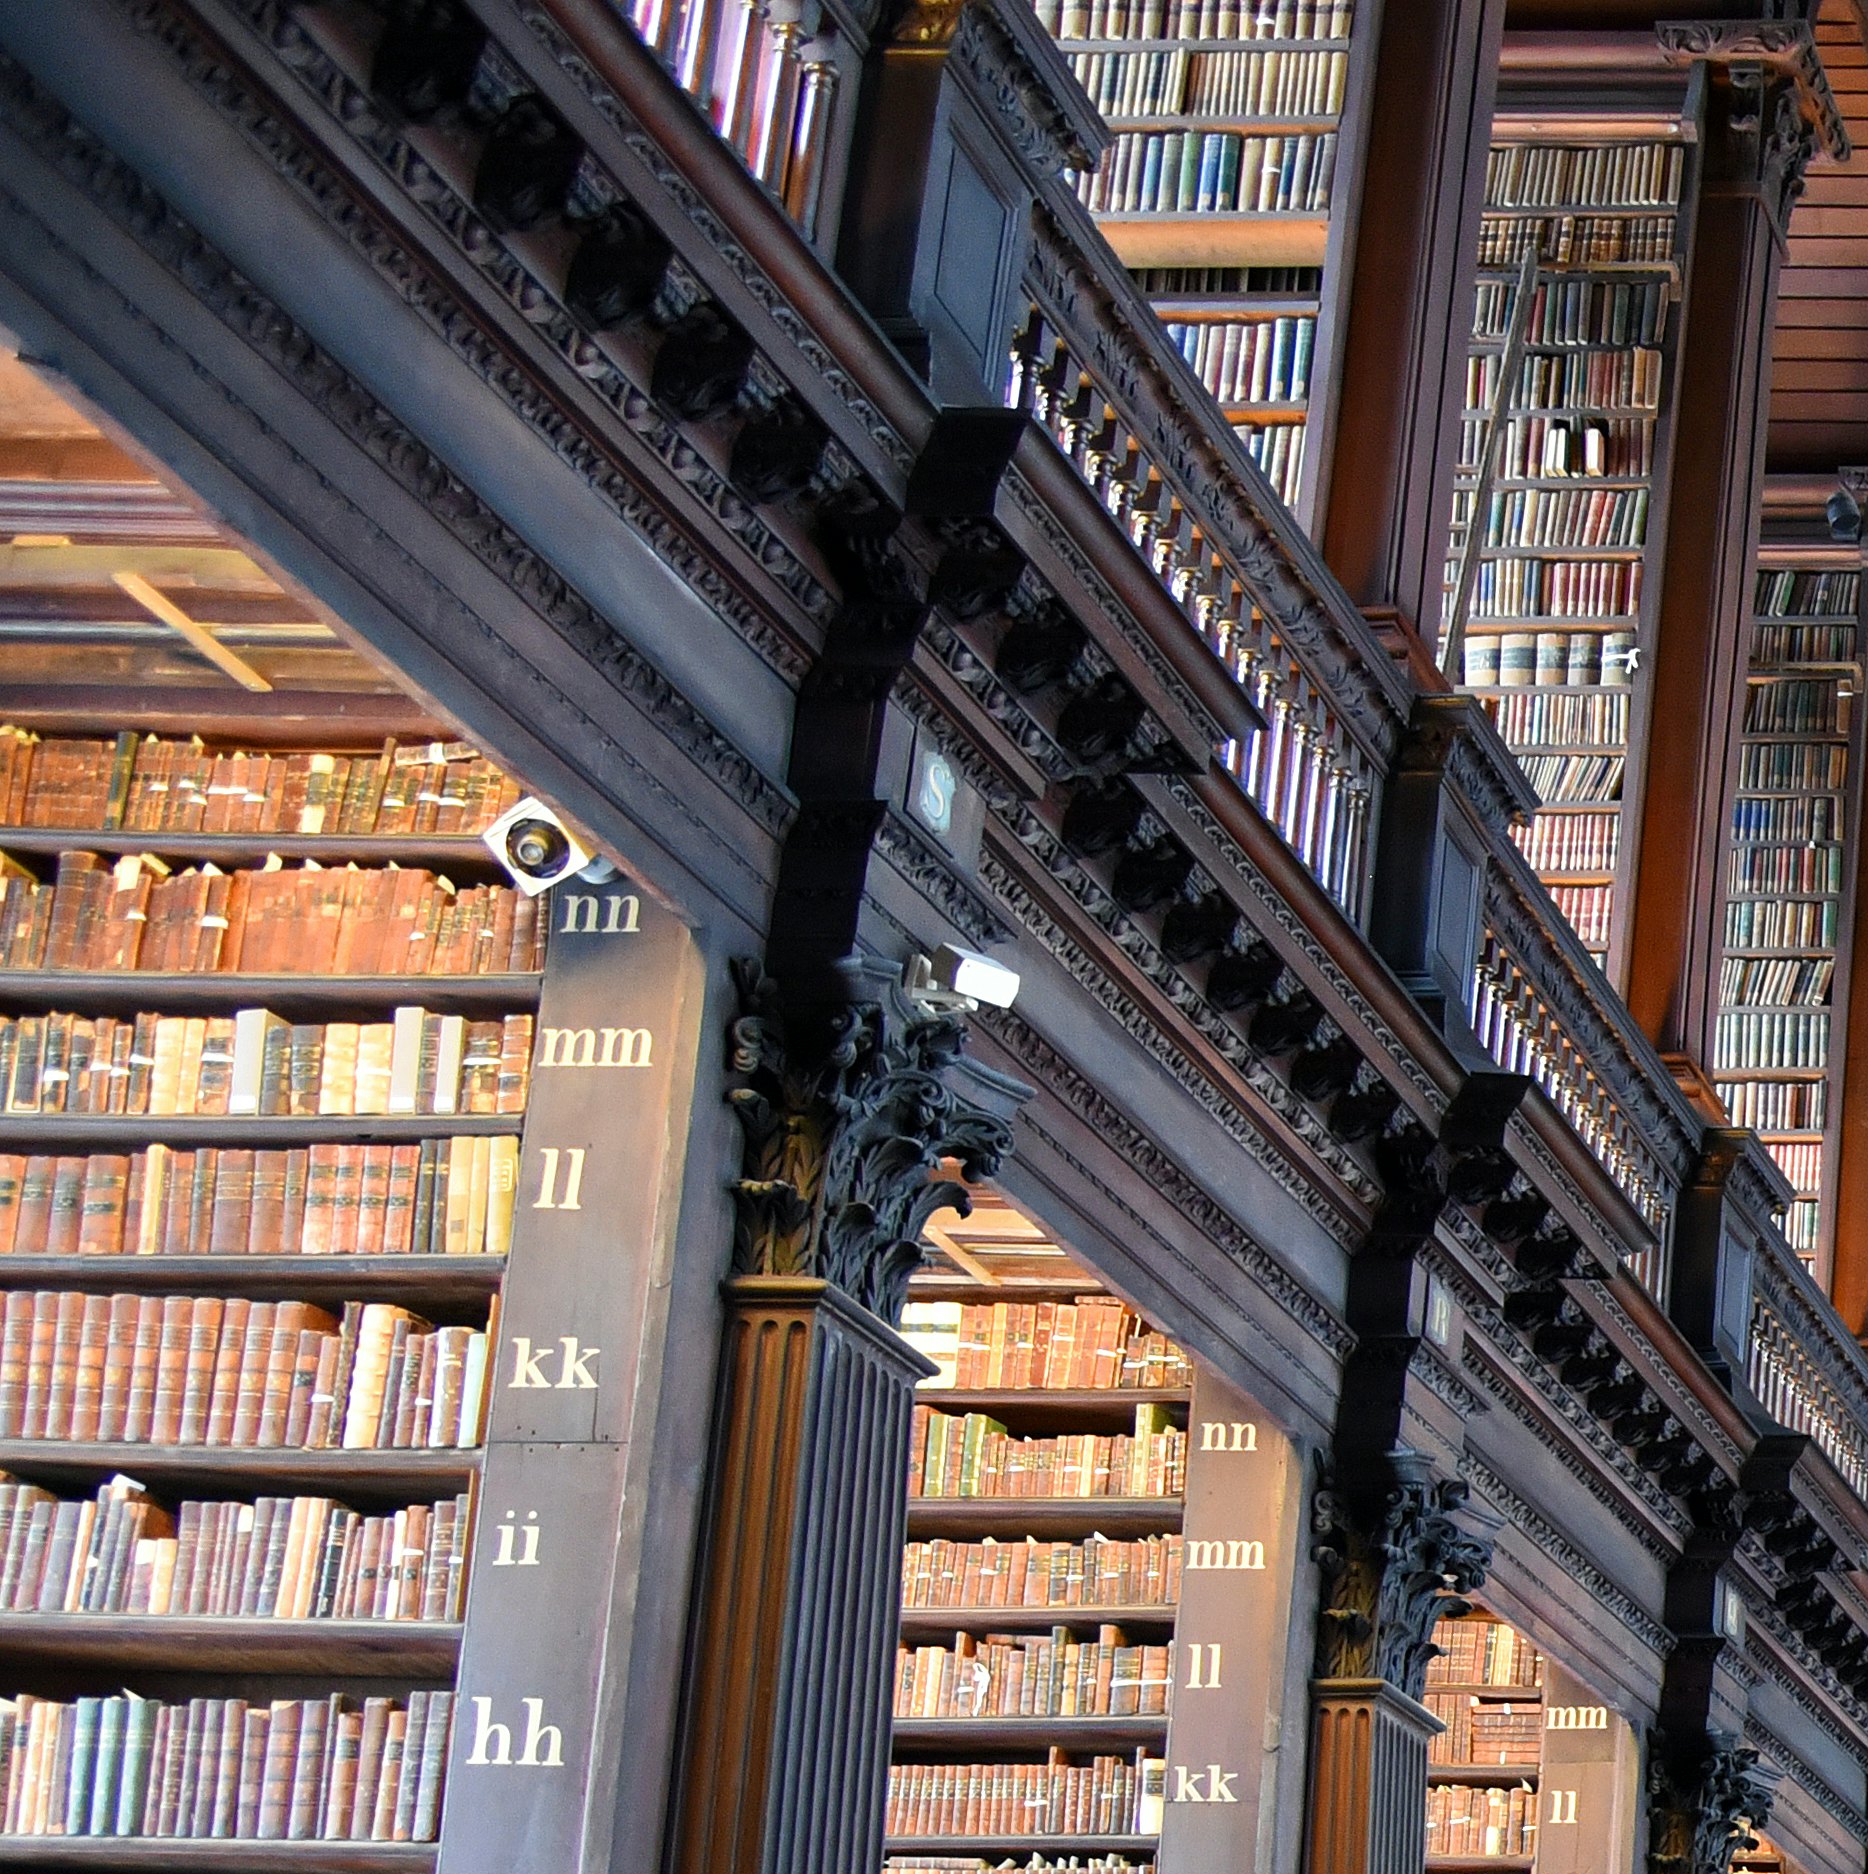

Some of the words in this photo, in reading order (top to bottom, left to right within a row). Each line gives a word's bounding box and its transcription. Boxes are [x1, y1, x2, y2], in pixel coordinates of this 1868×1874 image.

[921, 765, 950, 818] S
[560, 896, 640, 932] nn
[538, 1029, 652, 1066] mm
[533, 1148, 584, 1209] ll
[508, 1337, 600, 1388] kk
[1200, 1423, 1257, 1451] nn
[493, 1510, 539, 1565] ii
[1186, 1541, 1265, 1569] mm
[1185, 1644, 1221, 1688] ll
[466, 1697, 563, 1765] hh
[1544, 1707, 1607, 1729] mm
[1174, 1765, 1238, 1802] kk
[1549, 1791, 1577, 1823] ll
